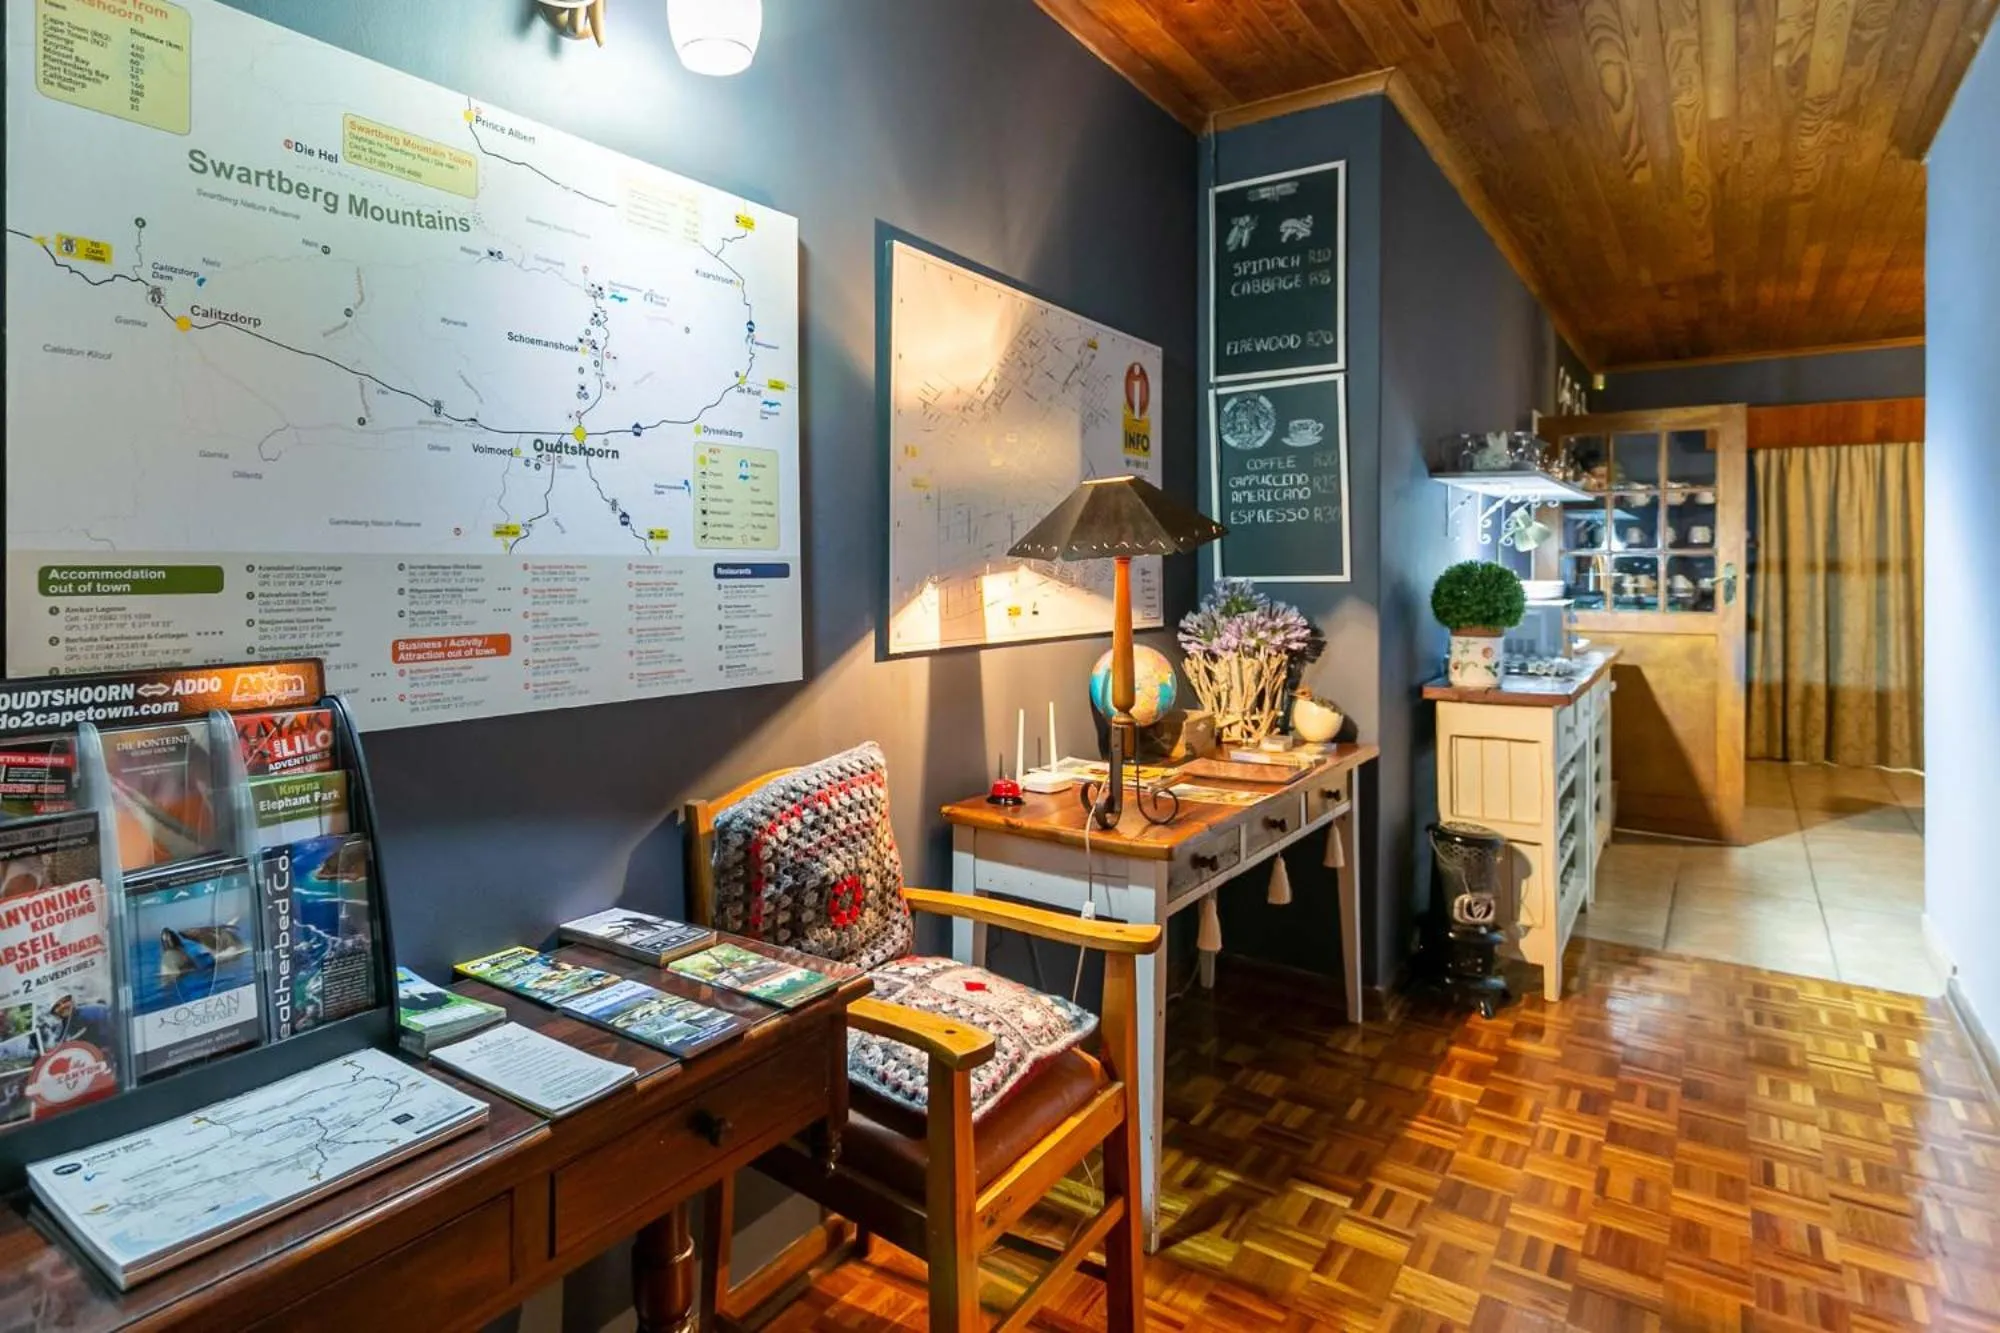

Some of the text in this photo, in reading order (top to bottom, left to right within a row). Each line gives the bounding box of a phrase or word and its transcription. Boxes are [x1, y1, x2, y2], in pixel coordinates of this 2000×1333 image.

[132, 0, 168, 19] from
[475, 115, 536, 144] Prince Albert
[294, 141, 339, 164] Die Hel
[187, 147, 340, 214] Swartberg
[348, 192, 471, 234] Mountains
[152, 262, 200, 279] Calitzdorp
[1233, 254, 1300, 277] SPINACH
[1231, 274, 1303, 297] CABBAGE
[190, 304, 262, 328] Calitzdorp
[1226, 333, 1301, 356] FIREWOOD
[472, 443, 515, 457] Volmoed
[533, 438, 620, 460] Oudtshoorn
[1124, 430, 1150, 453] INFO
[1246, 454, 1298, 471] COFFEE
[1231, 487, 1312, 505] AMERICANO
[1230, 507, 1310, 525] ESPRESSO
[48, 567, 167, 581] Accommodation
[48, 581, 132, 594] out of town
[398, 640, 442, 652] Business
[449, 638, 483, 649] Activity
[398, 650, 445, 662] Attraction
[446, 648, 462, 659] out
[0, 683, 136, 712] OUDTSHOORN
[172, 676, 223, 697] ADDO
[0, 700, 179, 731] do2capetown.com
[281, 728, 333, 757] LILO
[269, 751, 331, 772] ADVENTURES
[259, 789, 341, 812] Elephant Park
[279, 781, 321, 797] Knysna
[272, 848, 290, 891] Co.
[31, 901, 97, 933] KLOOFING
[15, 957, 40, 975] VIA
[21, 957, 96, 994] 2 ADVENTURES
